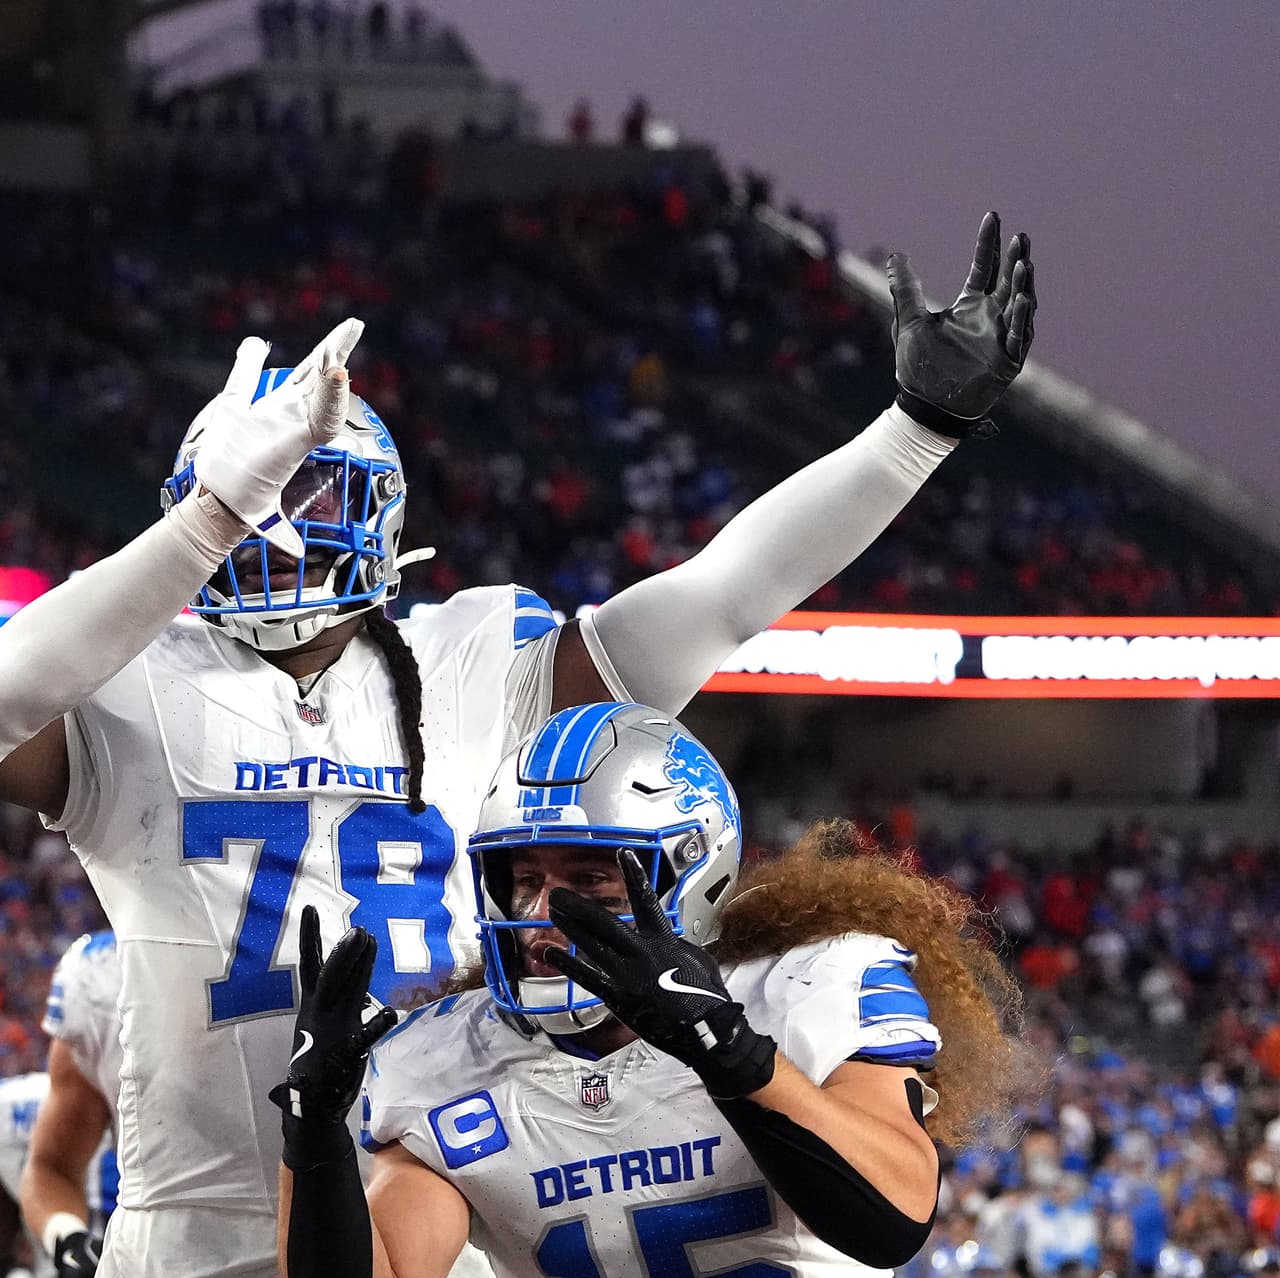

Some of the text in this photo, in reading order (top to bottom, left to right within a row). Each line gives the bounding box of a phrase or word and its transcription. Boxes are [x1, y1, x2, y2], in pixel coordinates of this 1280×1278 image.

[233, 756, 411, 795] DETROIT
[177, 796, 459, 1032] 78
[436, 1097, 497, 1151] C
[529, 1136, 722, 1209] DETROIT
